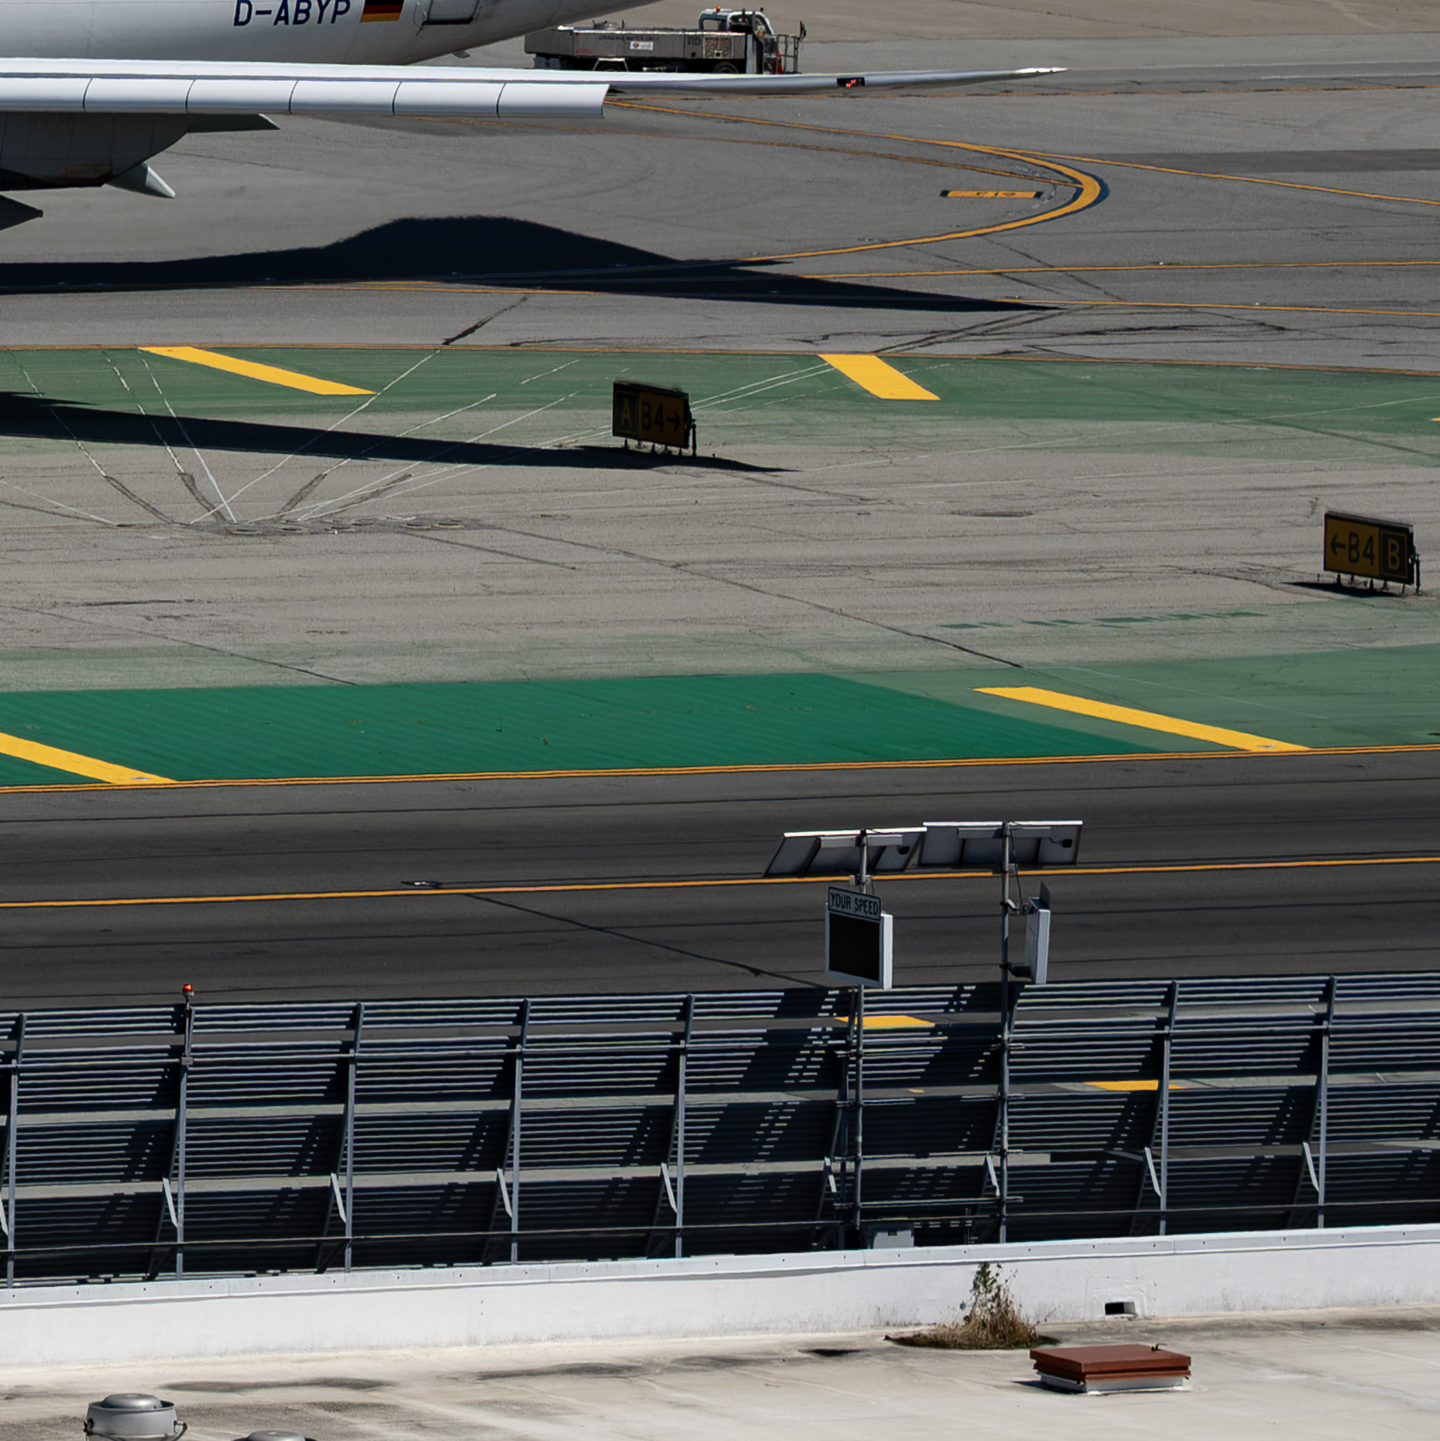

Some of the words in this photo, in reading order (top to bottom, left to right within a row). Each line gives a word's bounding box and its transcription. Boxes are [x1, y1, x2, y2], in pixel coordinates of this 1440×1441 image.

[620, 396, 633, 429] A
[641, 400, 665, 434] B4
[1348, 531, 1375, 568] B4
[1387, 538, 1400, 571] B
[830, 891, 852, 910] YOUR
[854, 897, 879, 916] SPEED
